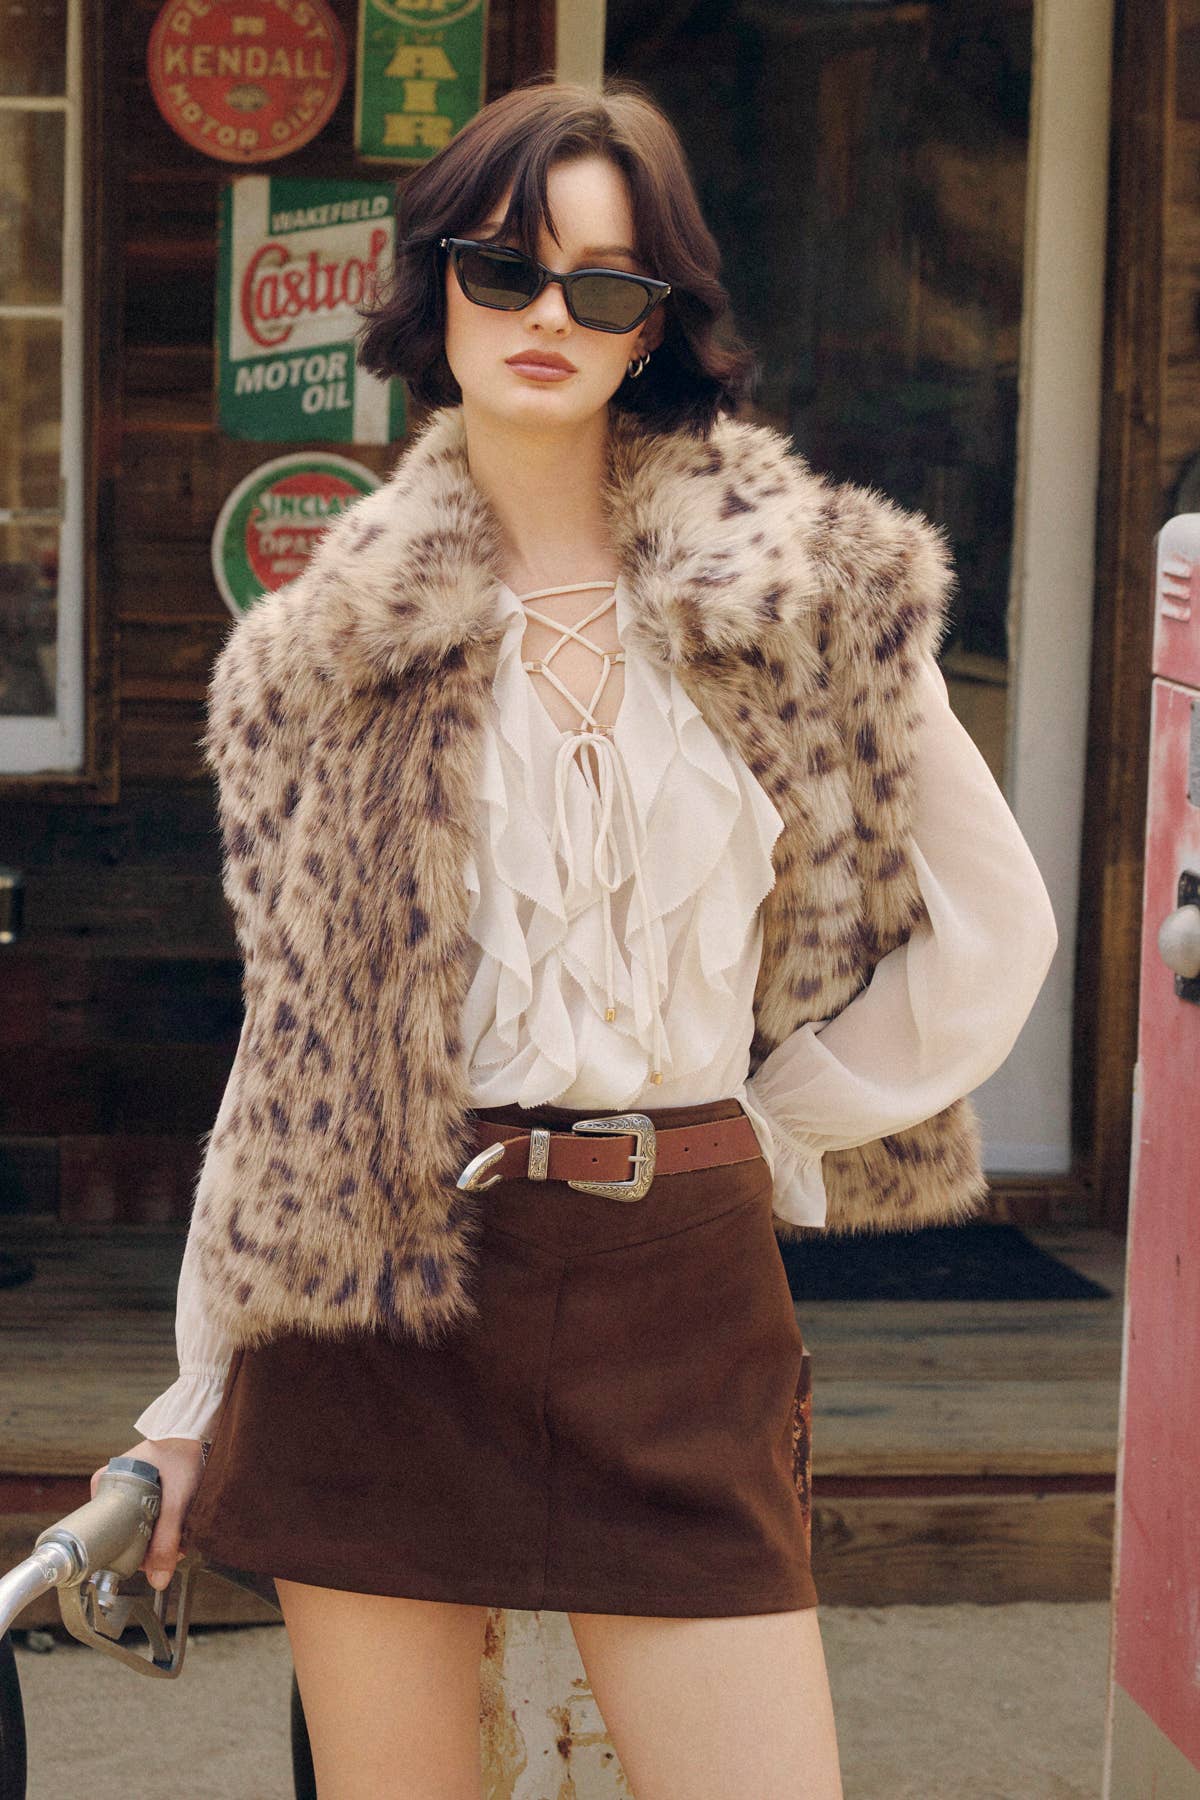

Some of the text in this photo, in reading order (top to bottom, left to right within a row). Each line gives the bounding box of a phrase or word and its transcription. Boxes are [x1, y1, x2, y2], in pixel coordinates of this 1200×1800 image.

[163, 45, 331, 79] KENDALL
[166, 84, 325, 147] MOTOR OILS
[384, 46, 458, 148] AIR
[272, 196, 389, 231] WAKEFIELD
[235, 352, 348, 395] MOTOR
[302, 381, 352, 414] OIL
